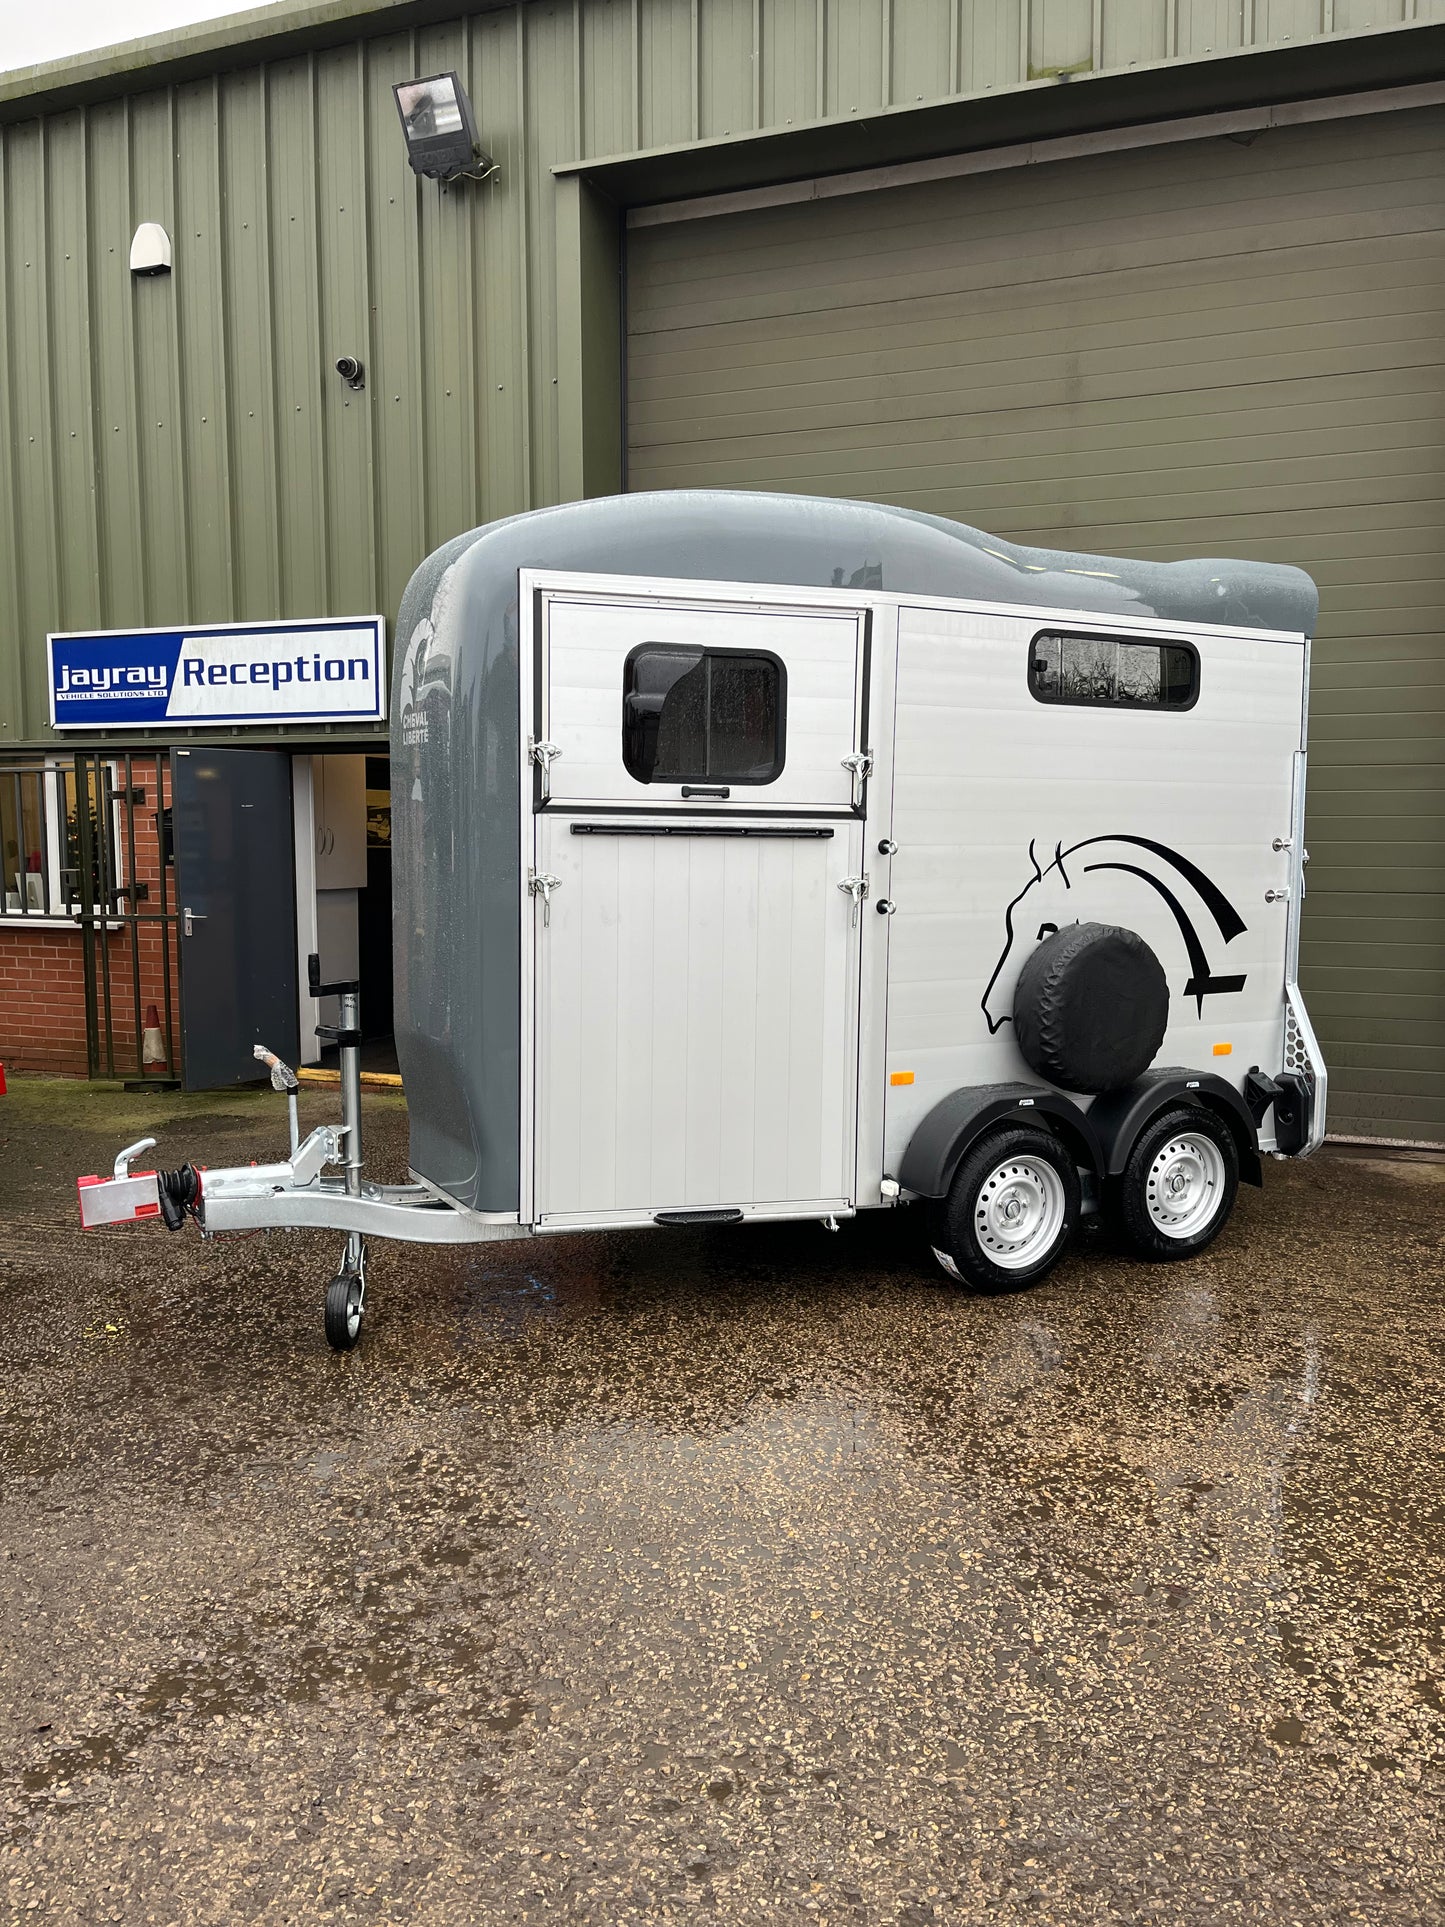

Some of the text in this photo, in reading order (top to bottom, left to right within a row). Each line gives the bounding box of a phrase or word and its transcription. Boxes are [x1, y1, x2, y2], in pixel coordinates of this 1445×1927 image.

[56, 665, 167, 692] jayray
[183, 653, 369, 691] Reception
[60, 692, 94, 700] VEHICLE
[403, 711, 429, 729] CHEVAL
